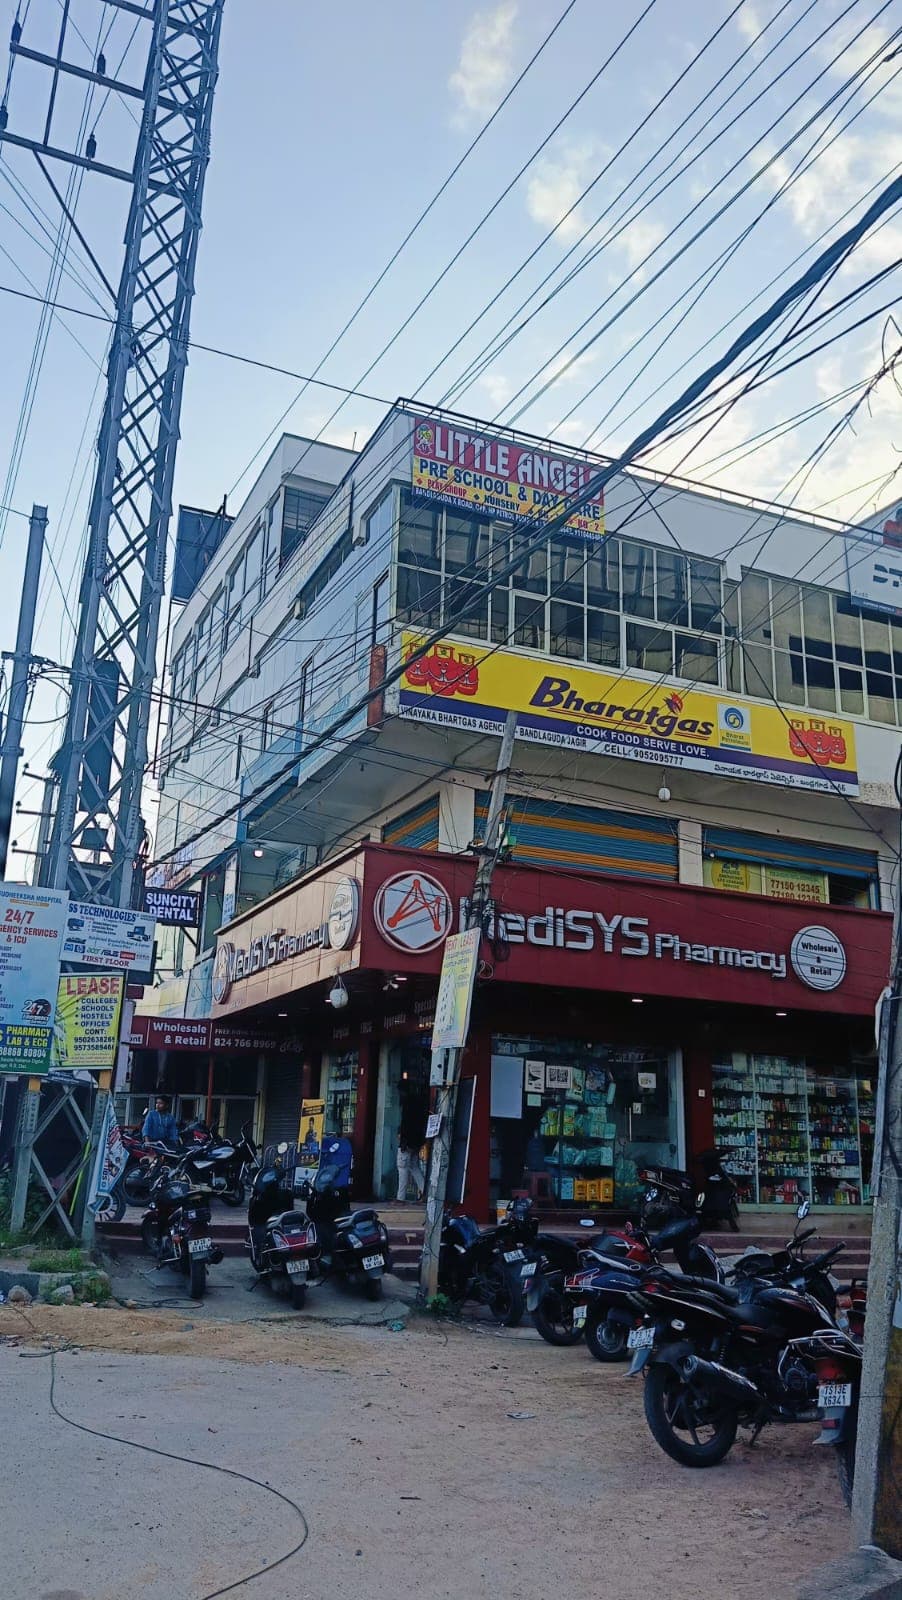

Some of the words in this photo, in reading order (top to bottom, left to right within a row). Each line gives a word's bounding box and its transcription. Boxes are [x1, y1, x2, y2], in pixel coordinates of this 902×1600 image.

[435, 426, 510, 477] LITTLE
[419, 458, 449, 480] PRE
[454, 468, 512, 497] SCHOOL
[518, 486, 527, 501] &
[533, 490, 560, 507] DAY
[564, 498, 600, 520] CRE
[484, 494, 520, 511] NURSERY
[529, 676, 715, 737] Bharatgas
[400, 705, 437, 721] VINAYAKA
[438, 712, 477, 728] BHARTGAS
[479, 721, 505, 733] AGENCI
[519, 727, 566, 745] BANDLAGUDA
[567, 737, 587, 747] JAGIR
[633, 748, 684, 766] 9052095777
[576, 725, 607, 739] COOK
[611, 731, 640, 745] FOOD
[643, 737, 677, 752] SERVE
[680, 744, 709, 758] LOVE.
[796, 882, 820, 894] 12345
[0, 890, 35, 901] UDHEEKSHA
[36, 895, 63, 905] HOSPITAL
[146, 892, 197, 908] SUNCITY
[4, 908, 35, 925] 24/7
[68, 903, 78, 913] SS
[80, 905, 137, 922] TECHNOLOGIES
[150, 905, 194, 921] DENTAL
[6, 934, 12, 943] &
[14, 936, 27, 944] ICU
[24, 927, 58, 939] SERVICES
[801, 941, 838, 954] Wholesale
[82, 955, 103, 964] FIRST
[105, 958, 130, 967] FLOOR
[655, 933, 787, 978] Pharmacy
[815, 956, 822, 964] &
[810, 966, 832, 976] Retail
[66, 977, 120, 995] LEASE
[6, 1026, 52, 1037] PHARMACY
[153, 1022, 207, 1034] Wholesale
[6, 1036, 22, 1046] LAB
[24, 1037, 30, 1046] &
[32, 1038, 48, 1047] ECG
[164, 1034, 172, 1044] &
[174, 1035, 207, 1045] Retail
[214, 1037, 232, 1047] 824
[234, 1038, 251, 1048] 766
[824, 1384, 847, 1395] TS13E
